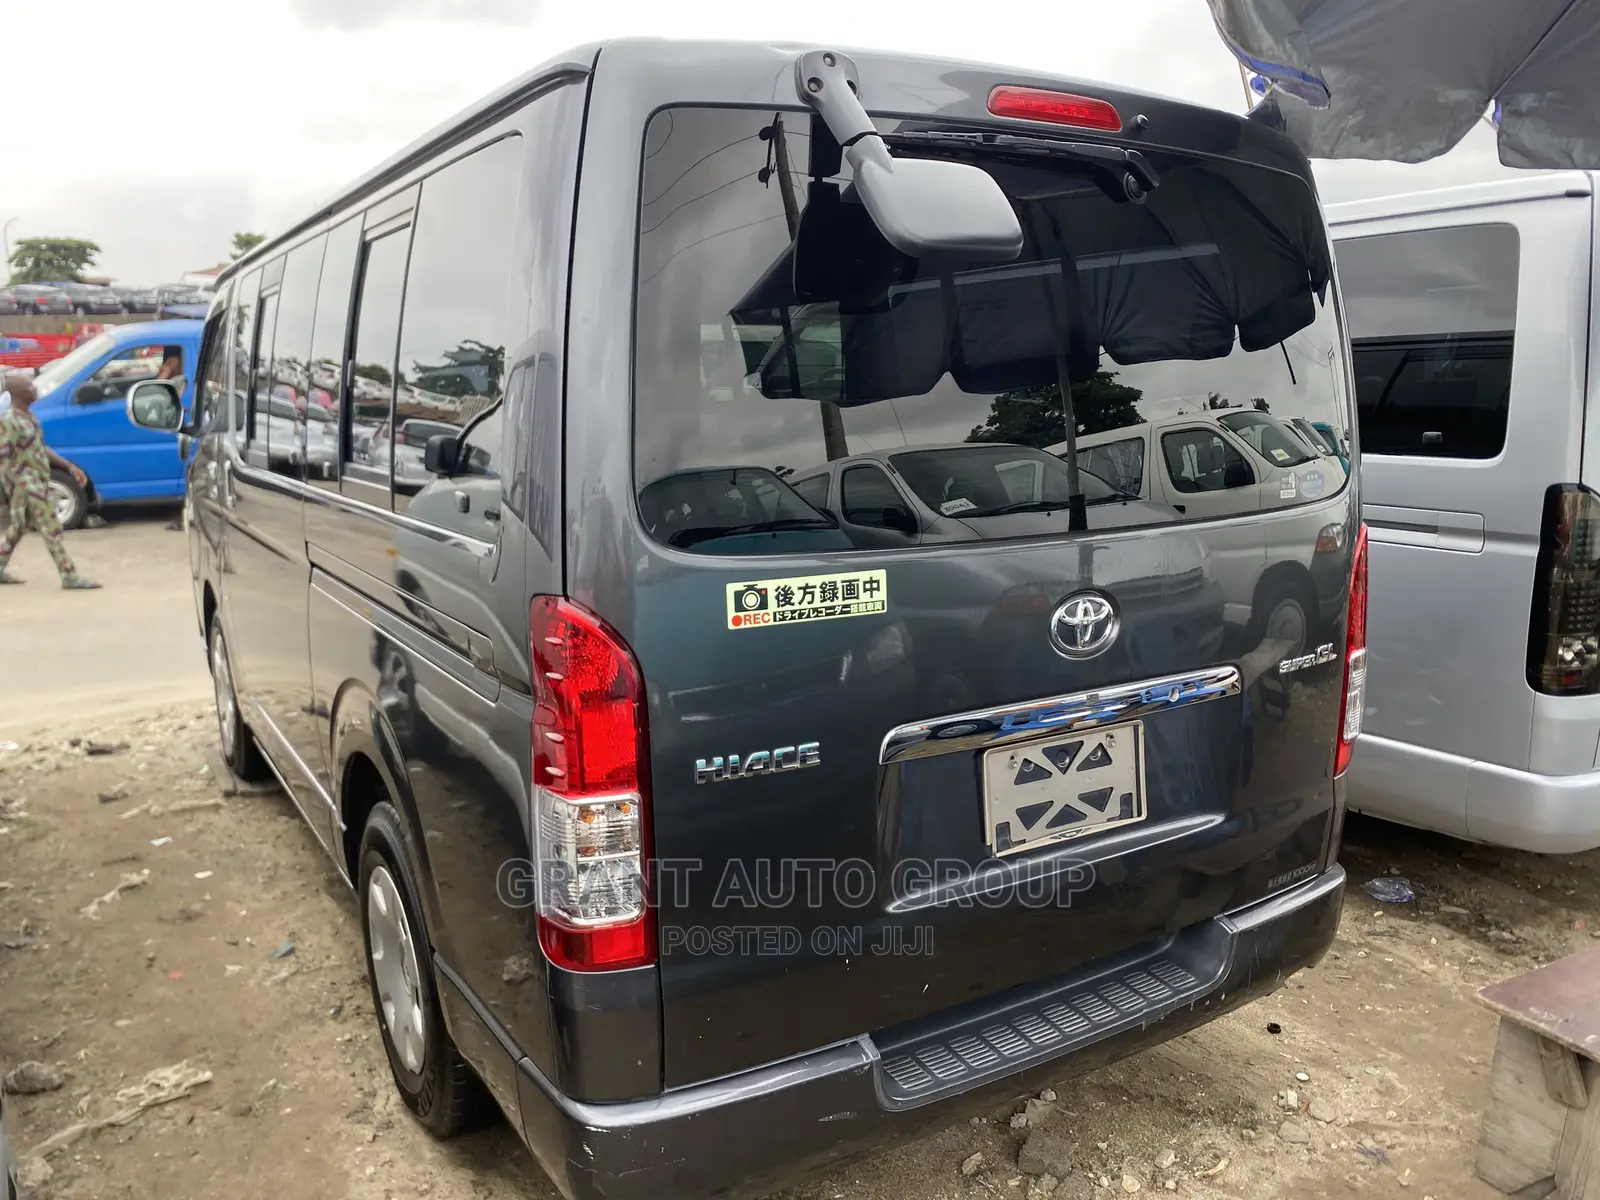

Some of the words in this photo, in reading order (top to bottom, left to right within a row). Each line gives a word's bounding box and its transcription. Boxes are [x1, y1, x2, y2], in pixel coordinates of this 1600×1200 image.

[774, 576, 881, 608] 後方録画中
[743, 612, 771, 626] REC
[695, 741, 821, 784] HIACE
